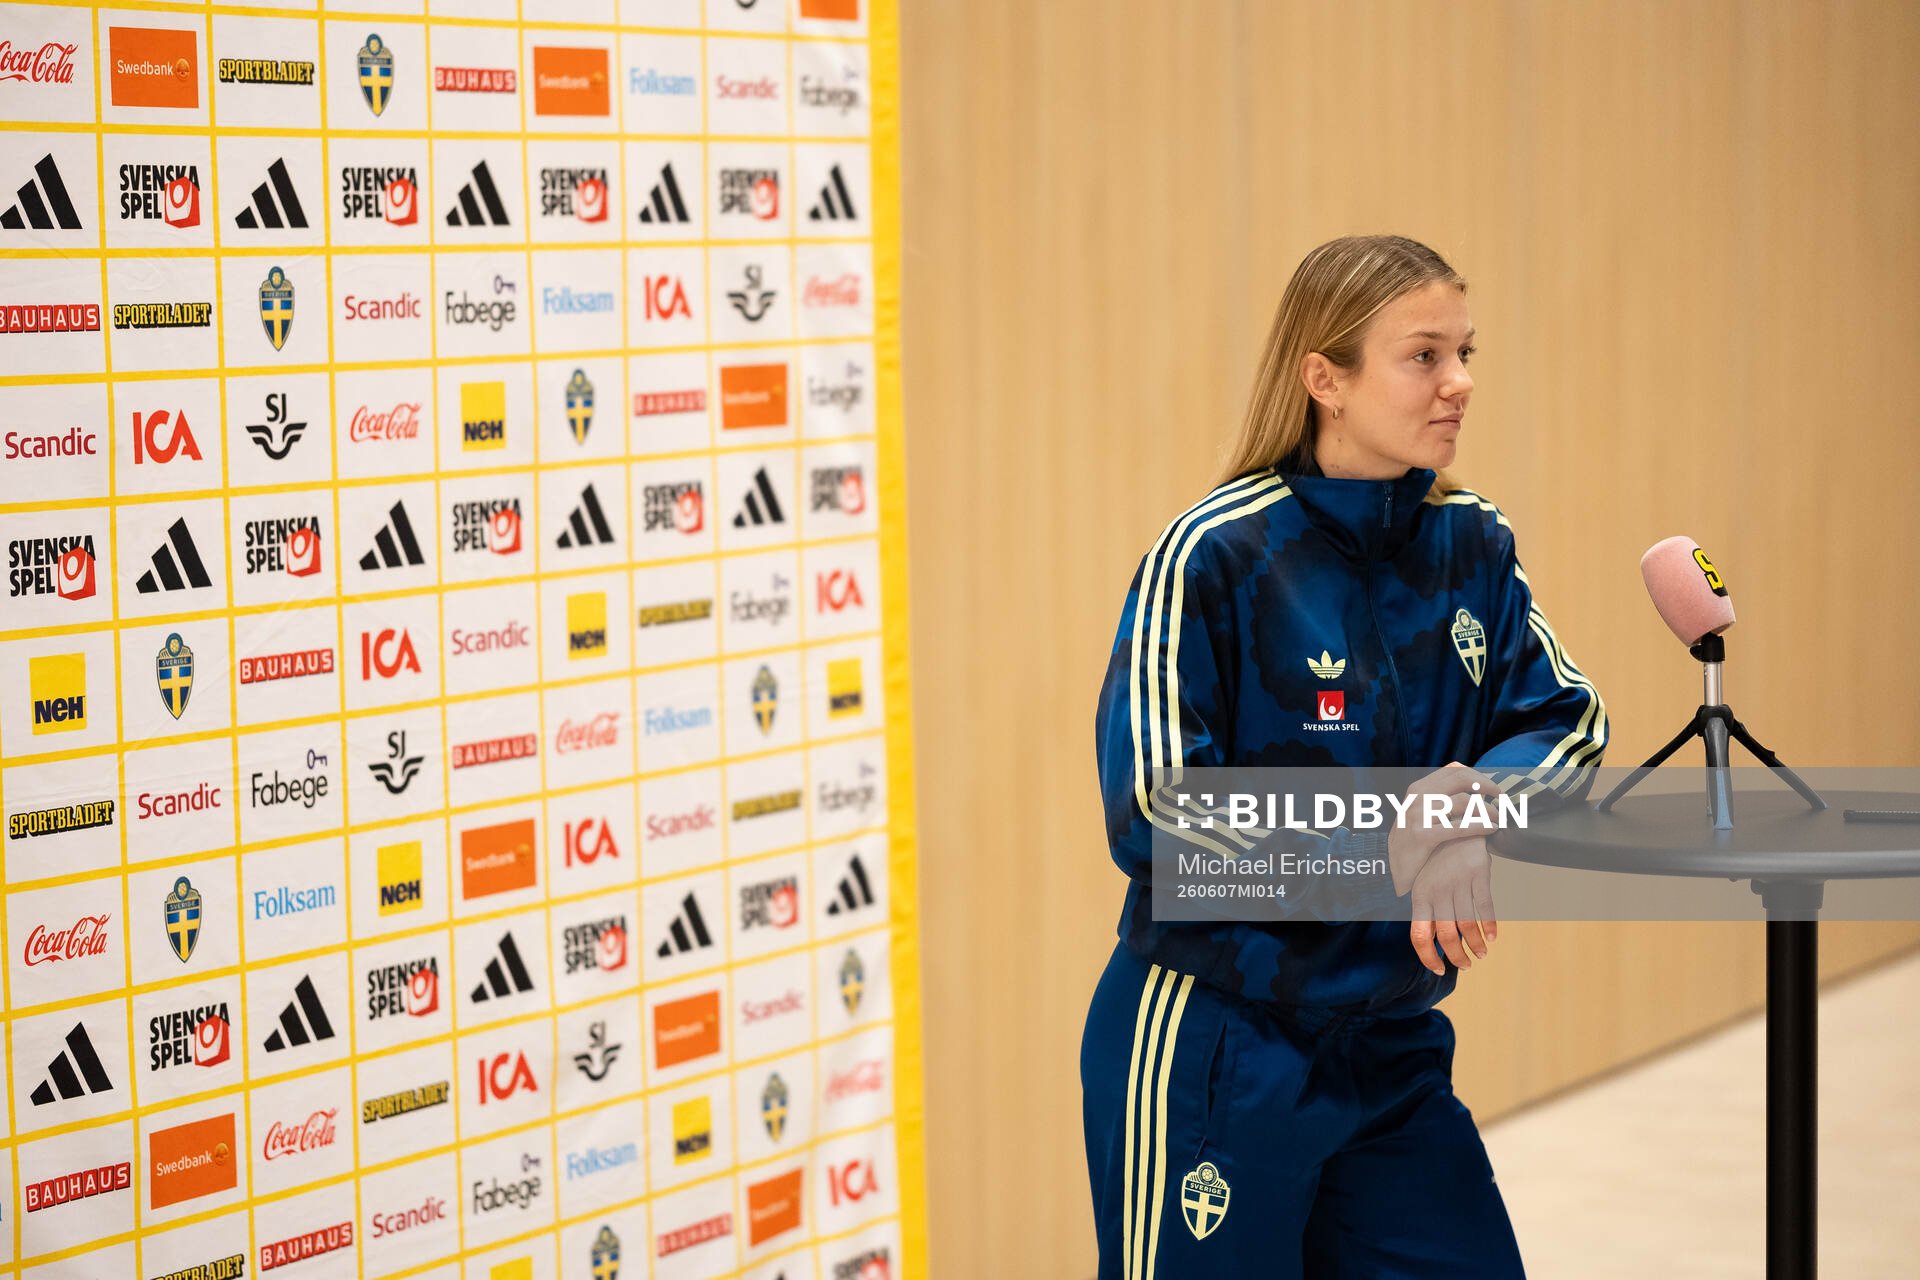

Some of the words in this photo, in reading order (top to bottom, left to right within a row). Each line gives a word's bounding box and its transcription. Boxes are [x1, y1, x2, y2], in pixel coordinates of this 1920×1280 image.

[117, 60, 173, 76] Swedbank
[219, 58, 314, 85] SPORTBLADET
[436, 69, 515, 92] BAUHAUS
[539, 74, 589, 89] Swedbank
[630, 67, 695, 95] Folksam
[716, 70, 778, 99] Scandic
[120, 193, 162, 219] SPEL
[343, 193, 383, 218] SPEL
[542, 193, 574, 217] SPEL
[744, 265, 762, 289] SJ
[344, 293, 421, 320] Scandic
[445, 291, 516, 331] Fabege
[542, 287, 614, 315] Folksam
[644, 275, 692, 321] ICA
[114, 303, 211, 329] SPORTBLADET
[266, 393, 288, 425] SJ
[349, 403, 422, 443] Coca-Cola
[5, 427, 97, 460] Scandic
[133, 409, 203, 465] ICA
[453, 527, 487, 553] SPEL
[246, 547, 284, 575] SPEL
[9, 568, 56, 598] SPEL
[816, 568, 863, 614] ICA
[452, 620, 529, 656] Scandic
[1458, 630, 1480, 638] SVERIGE
[241, 650, 333, 683] BAUHAUS
[361, 627, 422, 680] ICA
[644, 706, 711, 736] Folksam
[1303, 723, 1340, 731] SVENSKA
[387, 730, 406, 759] SJ
[453, 735, 536, 768] BAUHAUS
[138, 782, 222, 820] Scandic
[251, 770, 329, 809] Fabege
[9, 800, 114, 840] SPORTBLADET
[646, 805, 716, 840] Scandic
[564, 817, 620, 868] ICA
[466, 848, 516, 873] Swedbank
[254, 884, 335, 921] Folksam
[24, 912, 112, 967] Coca-Cola
[565, 945, 597, 975] SPEL
[368, 990, 405, 1021] SPEL
[589, 1020, 606, 1048] SJ
[150, 1039, 192, 1071] SPEL
[478, 1050, 538, 1105] ICA
[363, 1080, 449, 1124] SPORTBLADET
[263, 1107, 340, 1162] Coca-Cola
[156, 1150, 213, 1177] Swedbank
[566, 1140, 637, 1182] Folksam
[27, 1164, 129, 1210] BAUHAUS
[472, 1174, 542, 1215] Fabege
[1190, 1182, 1222, 1195] SVERIGE
[372, 1196, 446, 1239] Scandic
[261, 1222, 352, 1270] BAUHAUS
